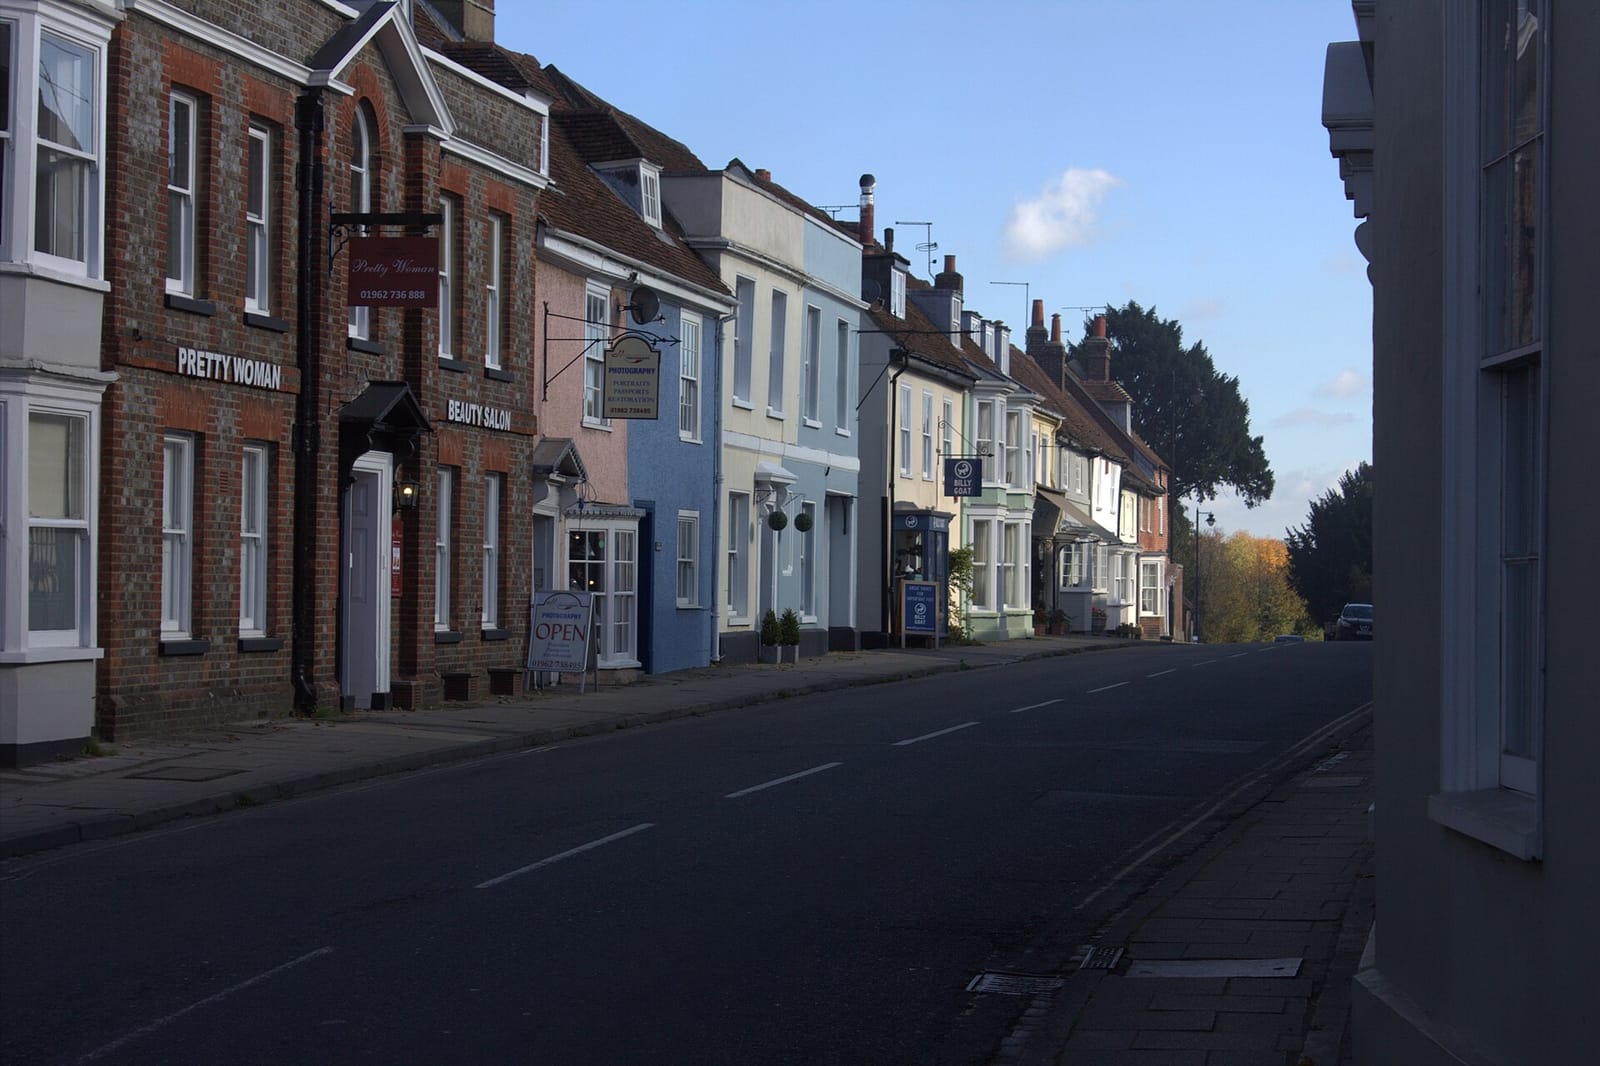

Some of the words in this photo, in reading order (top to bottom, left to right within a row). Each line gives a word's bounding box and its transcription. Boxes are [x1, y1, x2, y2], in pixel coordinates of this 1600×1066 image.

[351, 258, 389, 278] Pretty
[392, 257, 436, 273] Woman
[360, 290, 388, 299] 01962
[390, 290, 407, 299] 736
[408, 290, 425, 299] 888
[177, 346, 231, 381] PRETTY
[232, 357, 281, 390] WOMAN
[607, 367, 656, 375] PHOTOGRAPHY
[447, 399, 483, 426] BEAUTY
[483, 406, 511, 431] SALON
[953, 479, 972, 487] BILLY
[953, 487, 972, 495] GOAT
[541, 612, 582, 620] PHOTOGRAPHY
[535, 623, 586, 641] OPEN
